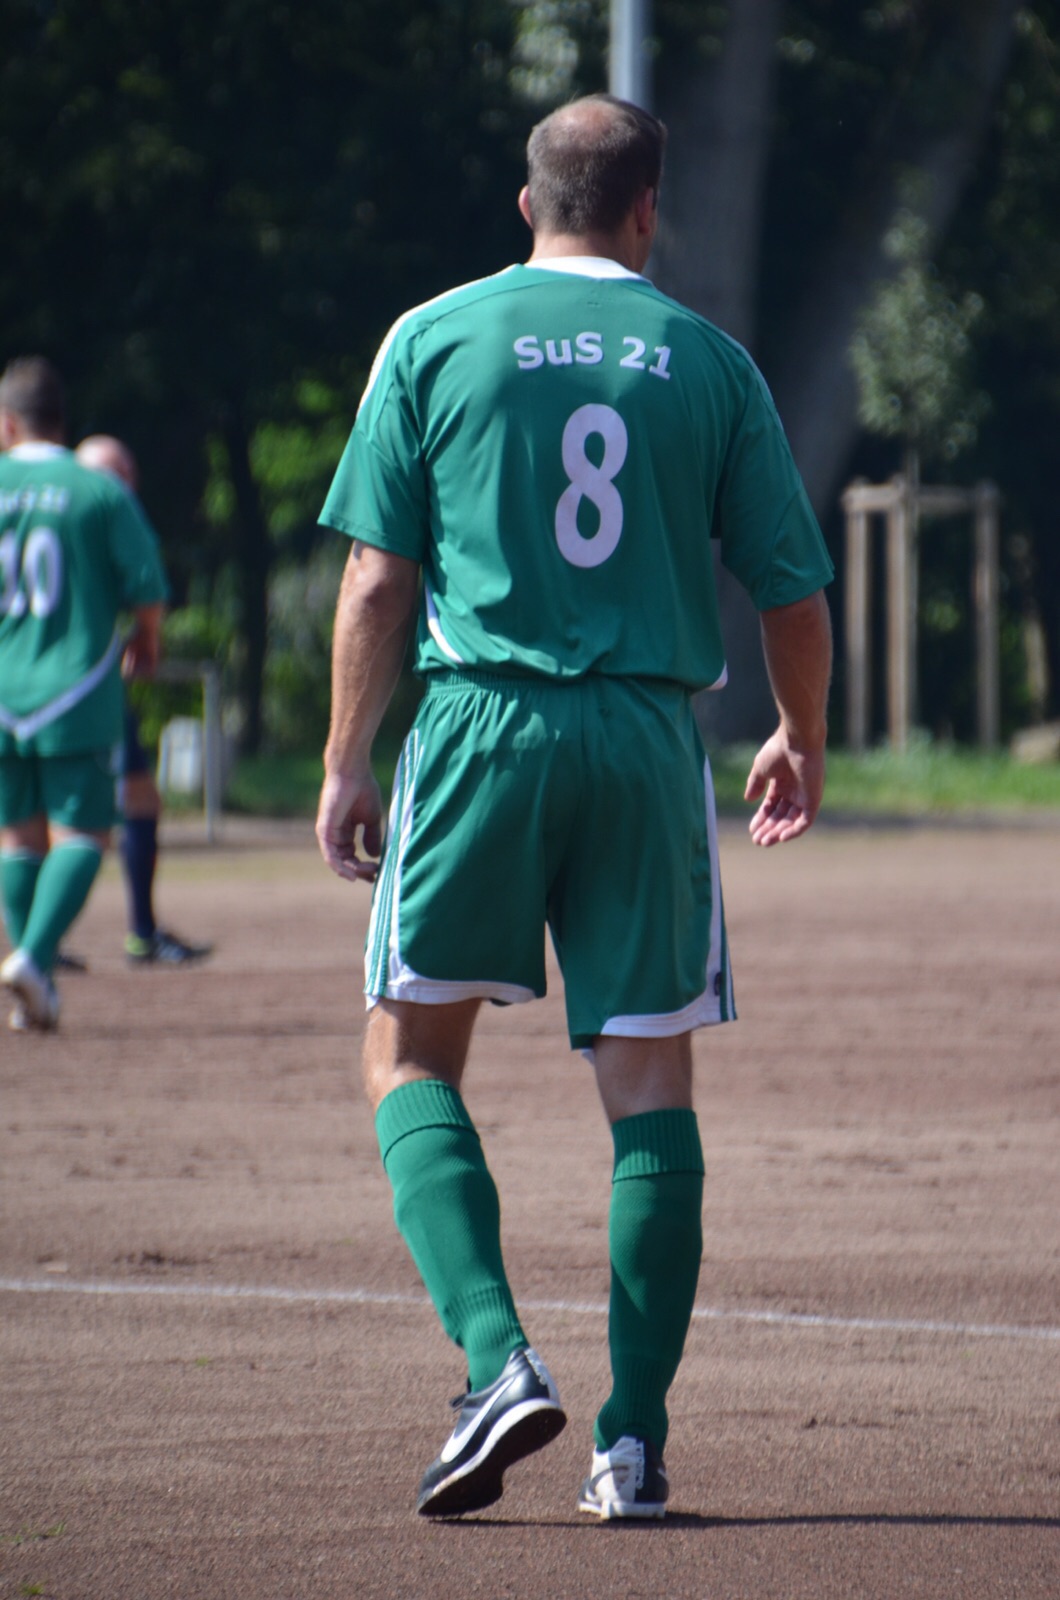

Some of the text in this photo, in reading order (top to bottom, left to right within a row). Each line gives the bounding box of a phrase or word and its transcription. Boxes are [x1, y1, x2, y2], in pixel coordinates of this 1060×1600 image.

[513, 331, 671, 380] SuS 21
[555, 403, 628, 569] 8
